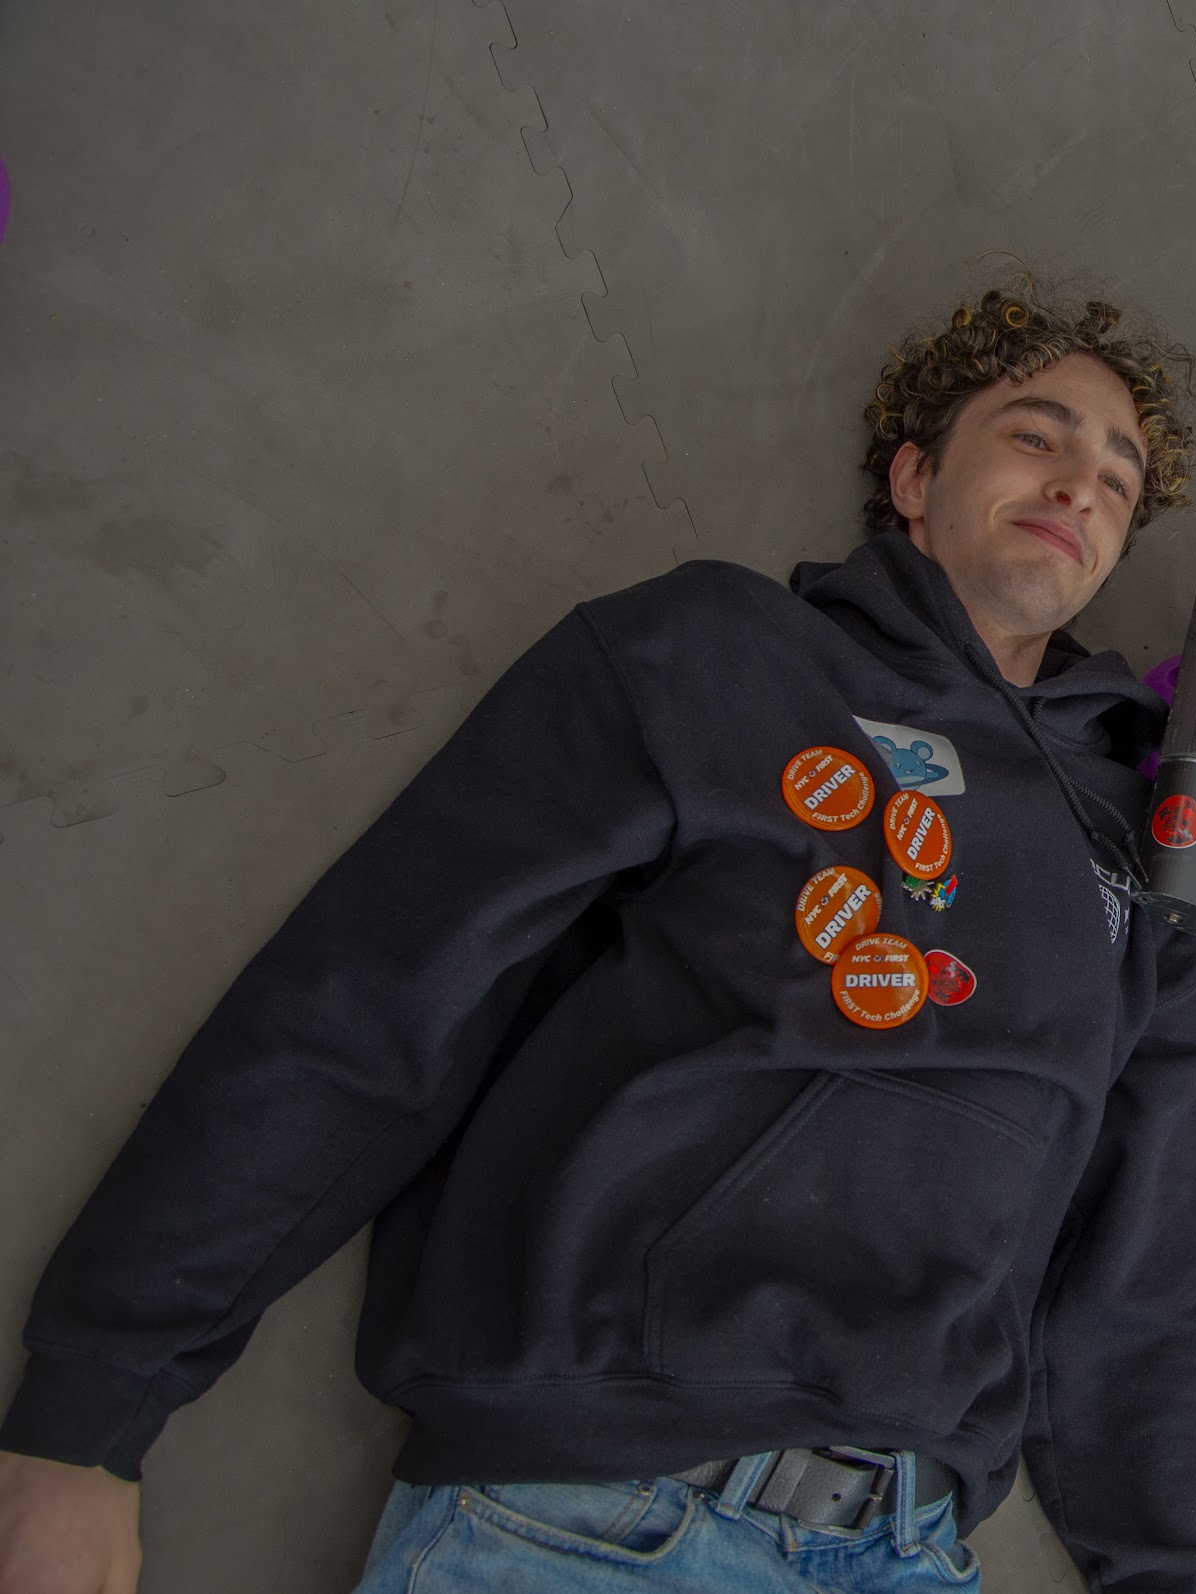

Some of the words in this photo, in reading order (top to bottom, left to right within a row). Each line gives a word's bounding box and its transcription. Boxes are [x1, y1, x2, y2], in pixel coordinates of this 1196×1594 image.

[787, 759, 803, 780] DRIVE
[801, 749, 823, 761] TEAM
[794, 775, 810, 790] NYC
[815, 754, 833, 772] FIRST
[803, 764, 856, 811] DRIVER
[812, 811, 839, 823] FIRST
[840, 808, 859, 822] Tech
[857, 771, 869, 810] Challenge
[889, 806, 898, 831] DRIVE
[894, 792, 910, 807] TEAM
[896, 824, 907, 841] NYC
[907, 797, 918, 818] FIRST
[906, 807, 935, 861] DRIVER
[937, 813, 949, 855] Challenge
[915, 862, 934, 873] FIRST
[934, 854, 946, 869] Tech
[797, 883, 814, 912] DRIVE
[810, 867, 836, 885] TEAM
[804, 904, 822, 926] NYC
[827, 872, 848, 898] FIRST
[814, 884, 872, 950] DRIVER
[851, 955, 871, 963] NYC
[884, 954, 910, 962] FIRST
[855, 937, 880, 951] DRIVE
[883, 937, 907, 950] TEAM
[845, 973, 916, 988] DRIVER
[840, 990, 861, 1013] FIRST
[860, 1010, 882, 1021] Tech
[884, 989, 921, 1021] Challenge
